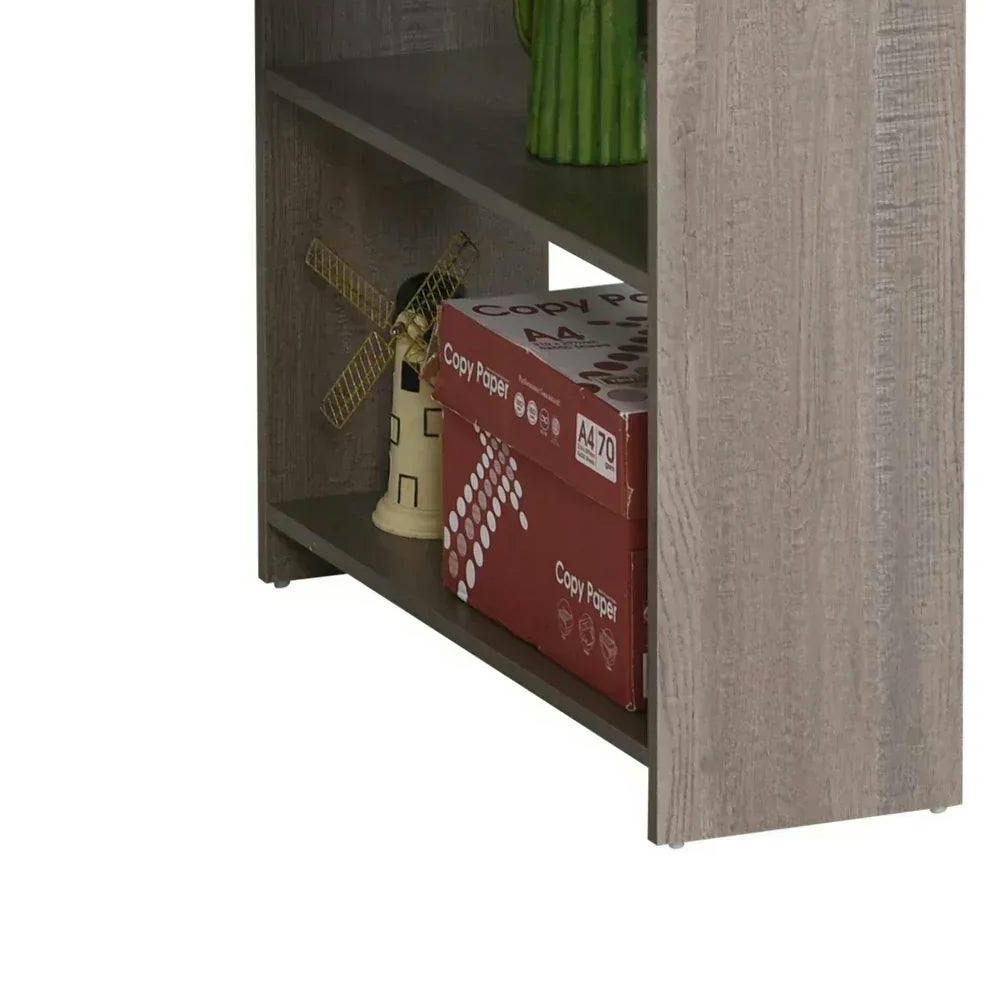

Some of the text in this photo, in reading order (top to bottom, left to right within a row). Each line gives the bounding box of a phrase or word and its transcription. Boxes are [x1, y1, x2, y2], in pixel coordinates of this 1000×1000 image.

[472, 298, 590, 317] Copy
[523, 325, 586, 343] A4
[443, 342, 475, 383] Copy
[476, 360, 510, 400] Paper
[578, 419, 595, 451] A4
[598, 430, 615, 464] 70
[555, 560, 618, 623] Copy Paper
